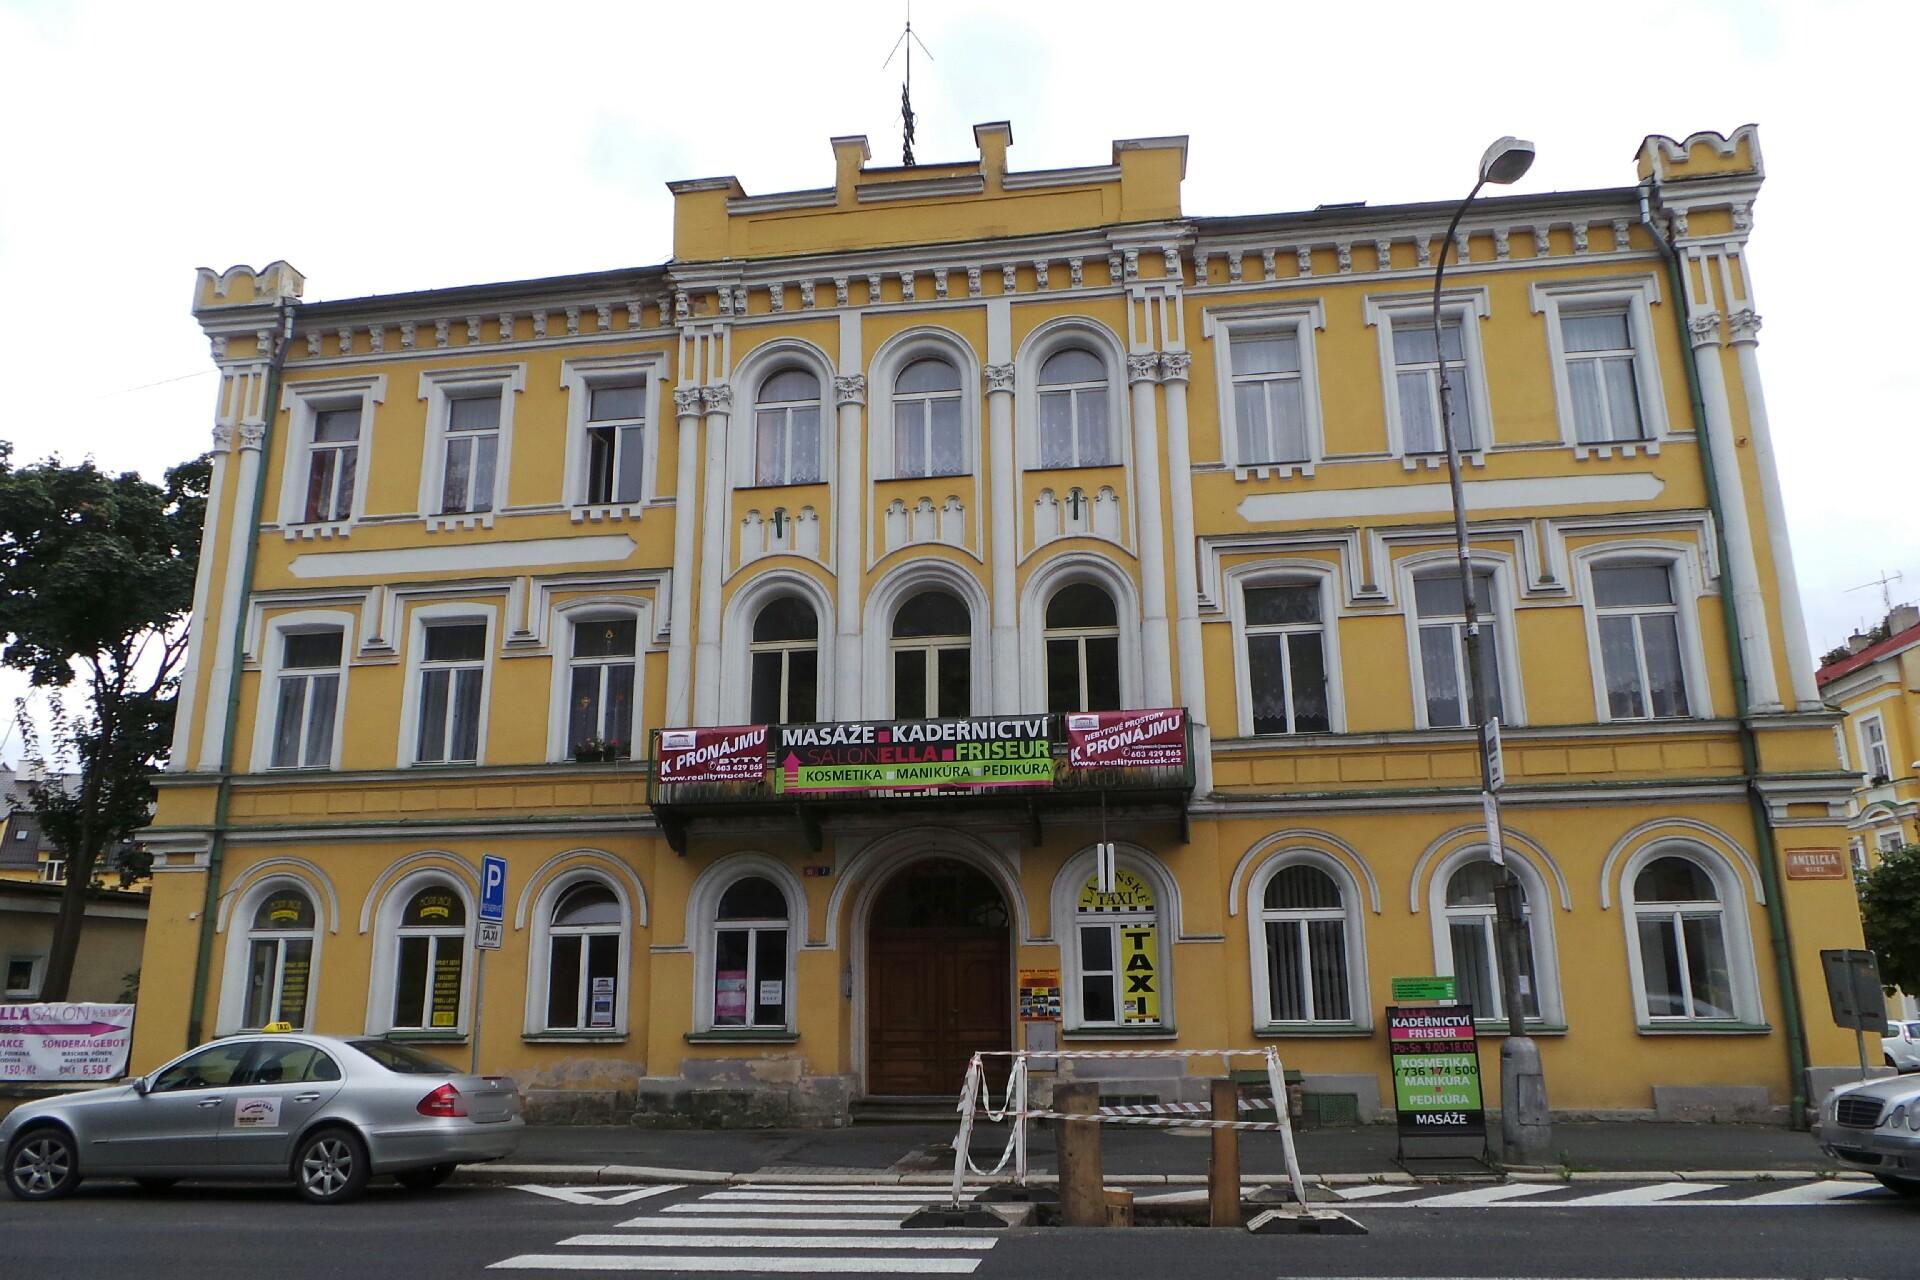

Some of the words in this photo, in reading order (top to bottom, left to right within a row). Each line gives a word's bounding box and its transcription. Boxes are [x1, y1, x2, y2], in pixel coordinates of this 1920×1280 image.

[782, 724, 875, 746] MASÁŽE
[893, 717, 1049, 743] KADEŘNICTVÍ
[1085, 721, 1124, 741] NEBYTOVÉ
[1125, 712, 1164, 729] PROSTORY
[1071, 747, 1081, 762] K
[1086, 715, 1180, 757] PRONÁJMU
[661, 759, 671, 776] K
[676, 729, 765, 770] PRONÁJMU
[956, 740, 1050, 760] FRISEUR
[1072, 756, 1182, 767] www.realitymacek.cz
[806, 769, 882, 782] KOSMETIKA
[896, 763, 970, 780] MANIKÚRA
[983, 761, 1050, 776] PEDIKÚRA
[486, 864, 502, 899] P
[1097, 892, 1134, 906] TAXI
[482, 930, 498, 941] TAXI
[1125, 932, 1156, 1015] TAXI
[32, 1007, 90, 1020] SALON
[276, 1023, 290, 1031] TAXI
[1392, 1015, 1470, 1027] KADEŘNICTVÍ
[1408, 1028, 1456, 1038] FRISEUR
[42, 1039, 126, 1048] SONDERANGEBOT
[1401, 1057, 1470, 1068] KOSMETIKA
[1403, 1067, 1425, 1076] 736
[1430, 1066, 1451, 1076] 174
[1455, 1065, 1477, 1075] 500
[1416, 1112, 1468, 1125] MASÁŽE
